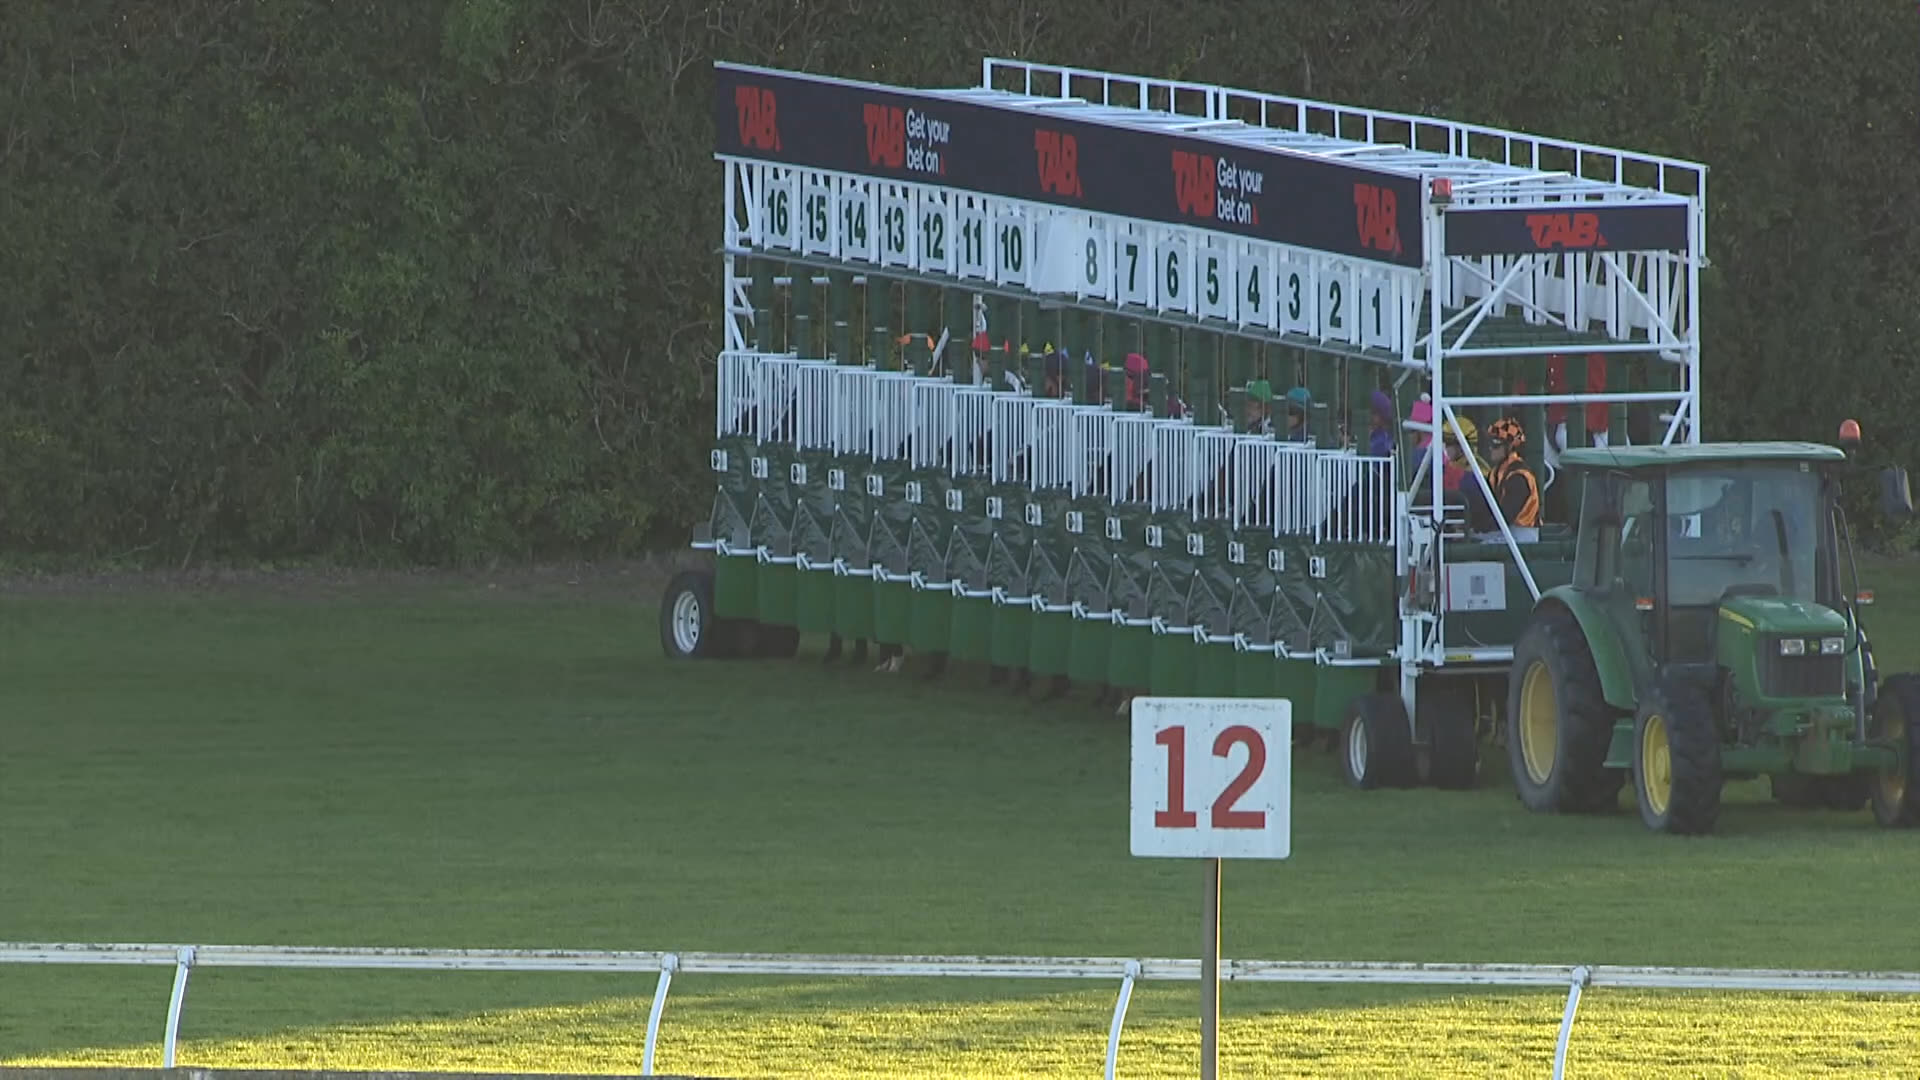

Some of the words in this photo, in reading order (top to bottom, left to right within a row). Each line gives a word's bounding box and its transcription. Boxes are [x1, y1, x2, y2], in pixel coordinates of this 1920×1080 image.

[864, 103, 902, 167] TAB
[906, 108, 925, 139] Get
[927, 119, 950, 144] your
[906, 145, 924, 172] bet
[926, 152, 938, 173] on
[1217, 158, 1237, 188] Get
[1238, 167, 1263, 194] your
[1172, 150, 1214, 217] TAB
[768, 189, 788, 238] 16
[807, 194, 826, 242] 15
[845, 199, 866, 248] 14
[885, 206, 904, 253] 13
[1218, 193, 1236, 221] bet
[1237, 203, 1250, 223] on
[924, 213, 943, 260] 12
[963, 218, 982, 266] 11
[1002, 224, 1022, 272] 10
[1086, 238, 1098, 284] 8
[1126, 245, 1138, 292] 7
[1166, 251, 1178, 298] 6
[1207, 257, 1219, 305] 5
[1248, 265, 1260, 312] 4
[1288, 272, 1300, 320] 3
[1329, 280, 1342, 328] 2
[1372, 288, 1380, 336] 1
[1155, 725, 1266, 828] 12
